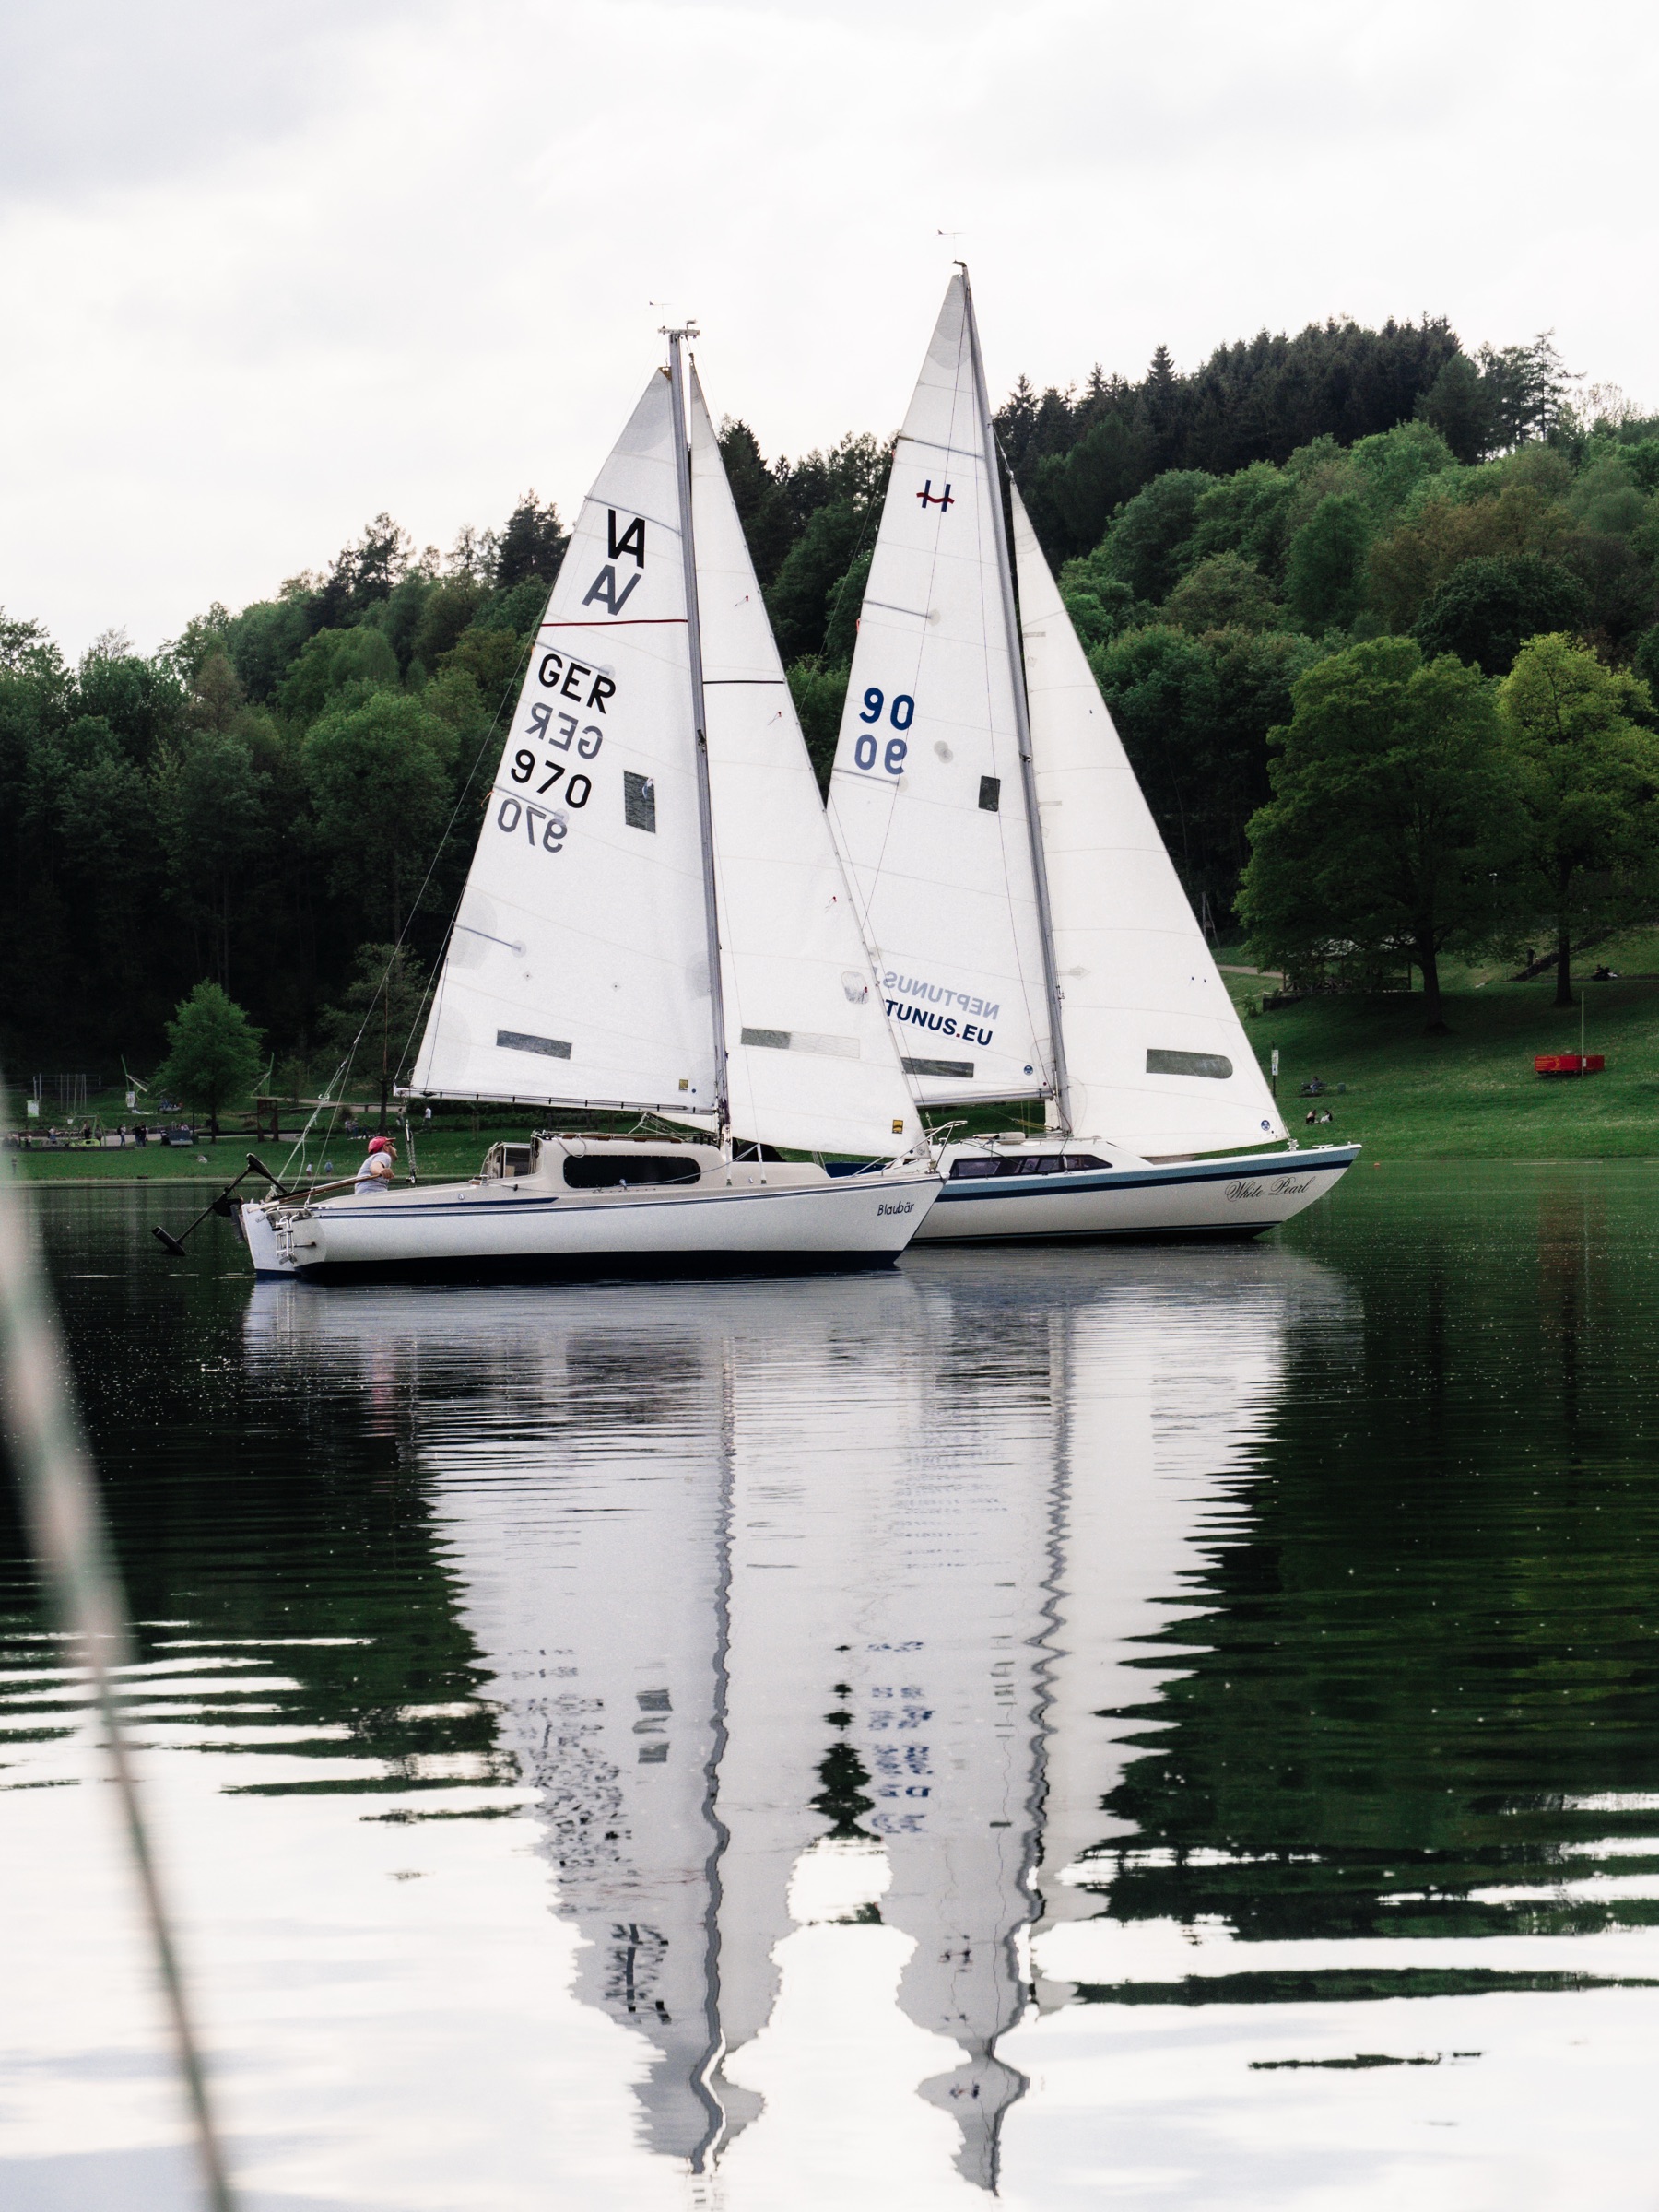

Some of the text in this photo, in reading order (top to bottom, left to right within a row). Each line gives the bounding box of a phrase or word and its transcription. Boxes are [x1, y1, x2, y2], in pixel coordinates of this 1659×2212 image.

[607, 509, 646, 569] VA
[538, 653, 617, 715] GER
[859, 688, 915, 731] 90
[510, 748, 593, 809] 970
[877, 1200, 915, 1216] Blaubär
[1224, 1176, 1316, 1203] White Pearl
